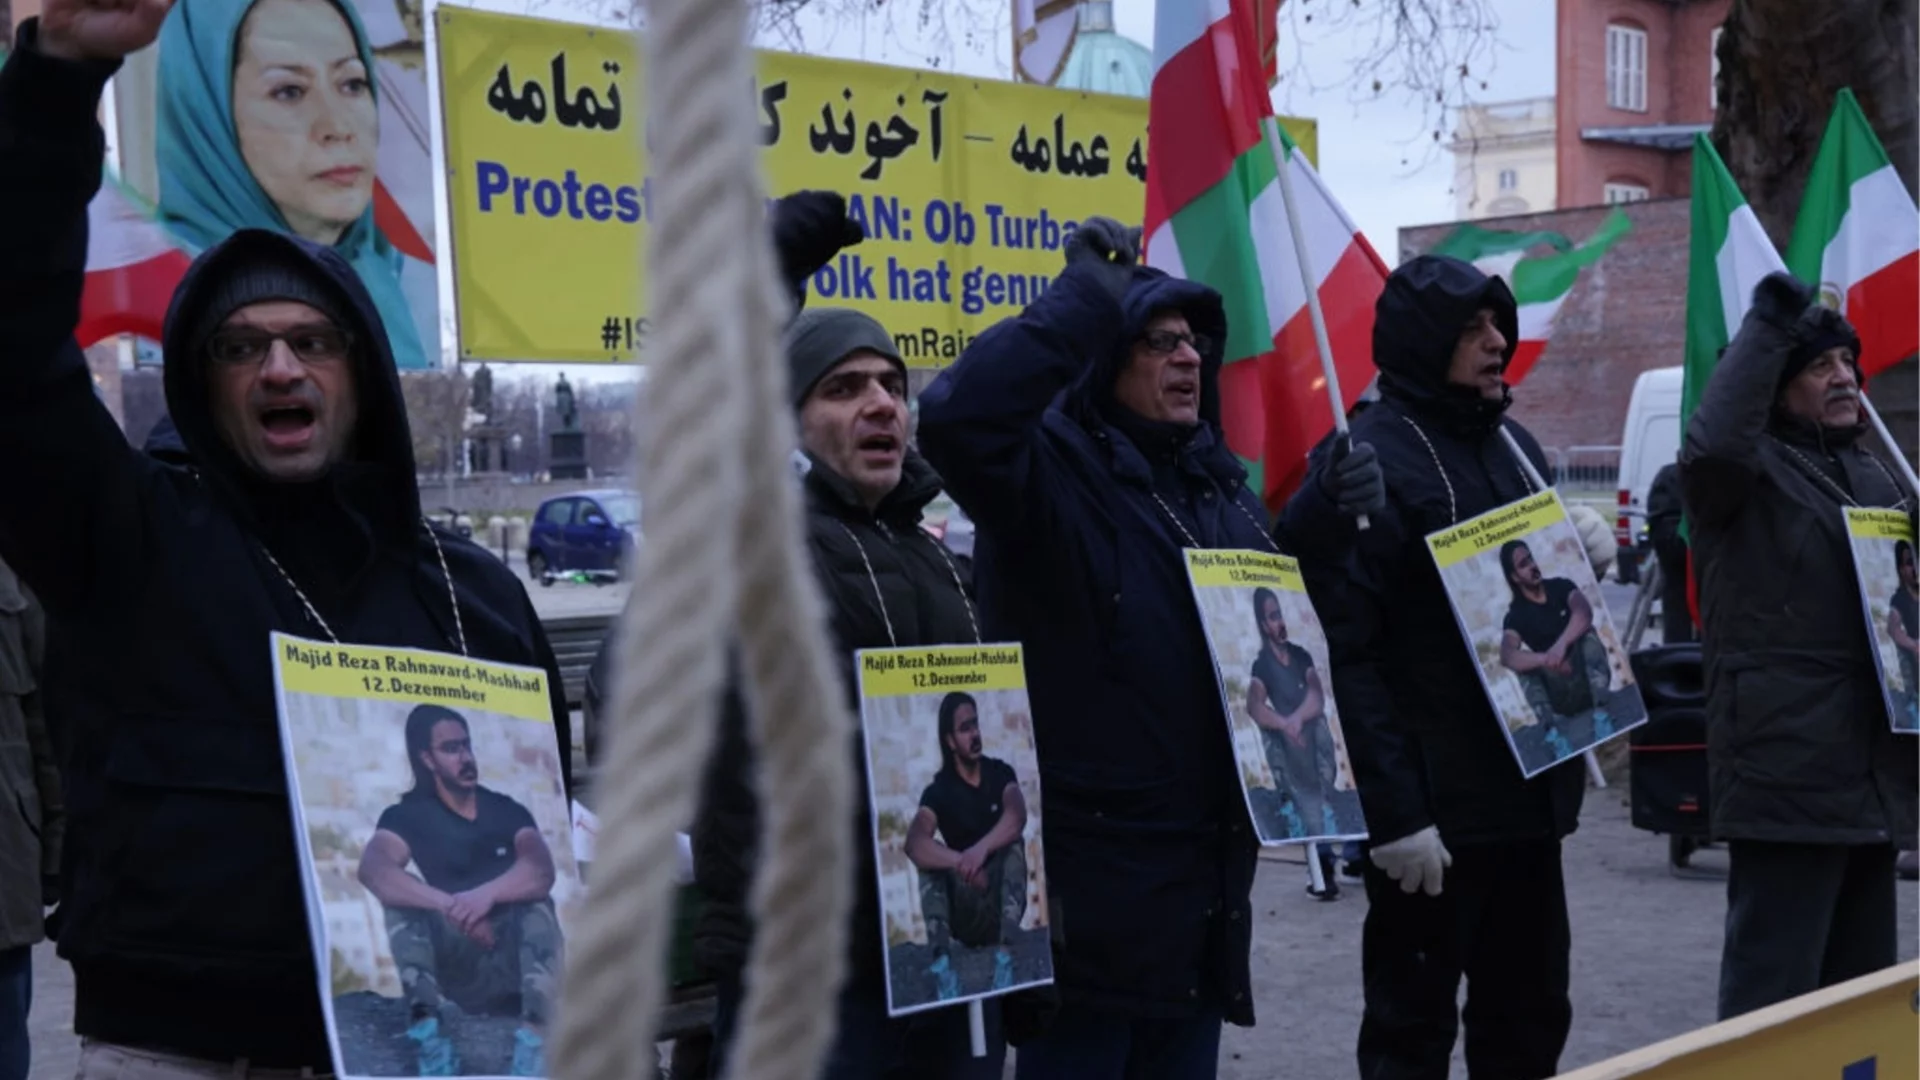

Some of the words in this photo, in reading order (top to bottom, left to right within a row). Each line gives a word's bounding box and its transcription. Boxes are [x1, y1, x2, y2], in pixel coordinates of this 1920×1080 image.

[486, 51, 622, 131] تمامه
[808, 87, 949, 181] آخوند
[1010, 112, 1111, 178] عمامه
[847, 193, 913, 242] AN:
[924, 199, 976, 247] Ob
[984, 204, 1079, 251] Turba
[801, 253, 878, 301] olk
[887, 256, 952, 303] hat
[960, 264, 1049, 315] genu
[285, 643, 333, 671] Majid
[338, 651, 381, 672] Reza
[385, 655, 542, 694] Rahnavard-Mashhad
[865, 654, 896, 675] Majid
